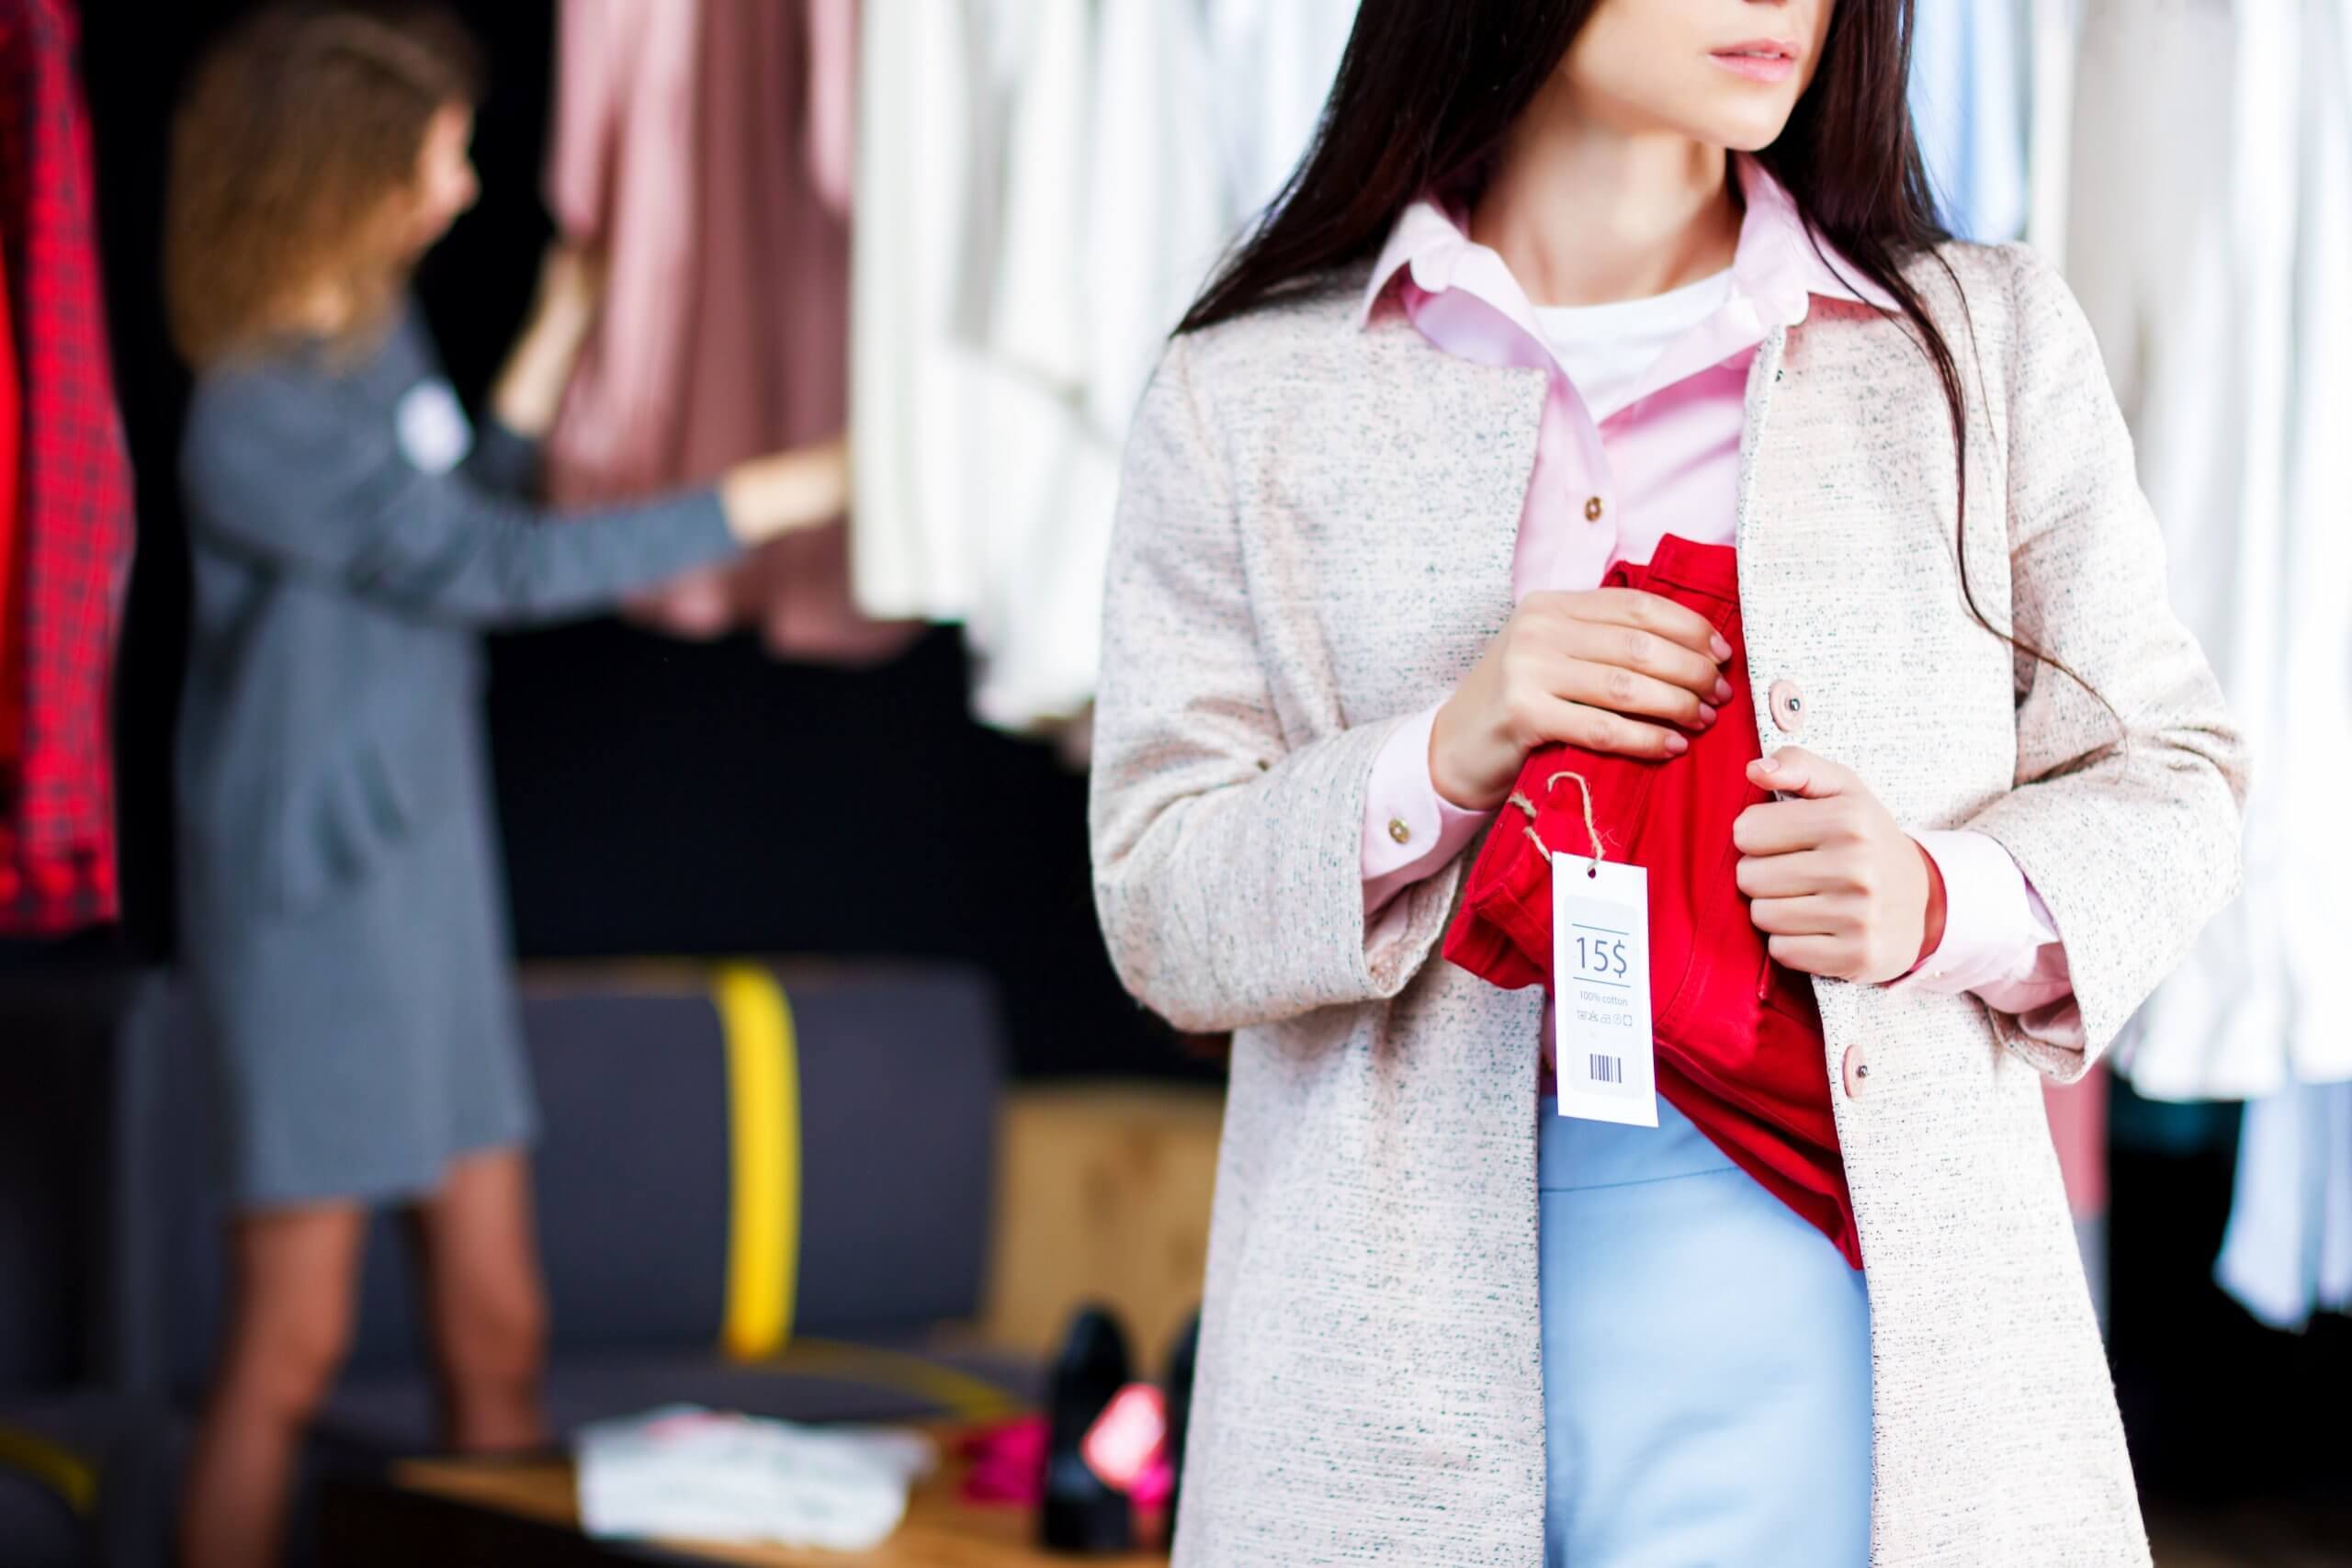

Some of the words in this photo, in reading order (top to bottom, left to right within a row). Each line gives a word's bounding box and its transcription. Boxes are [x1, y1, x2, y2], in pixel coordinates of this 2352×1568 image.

[1577, 937, 1627, 978] 15$
[1579, 990, 1601, 1001] 100%
[1602, 995, 1628, 1007] cotton
